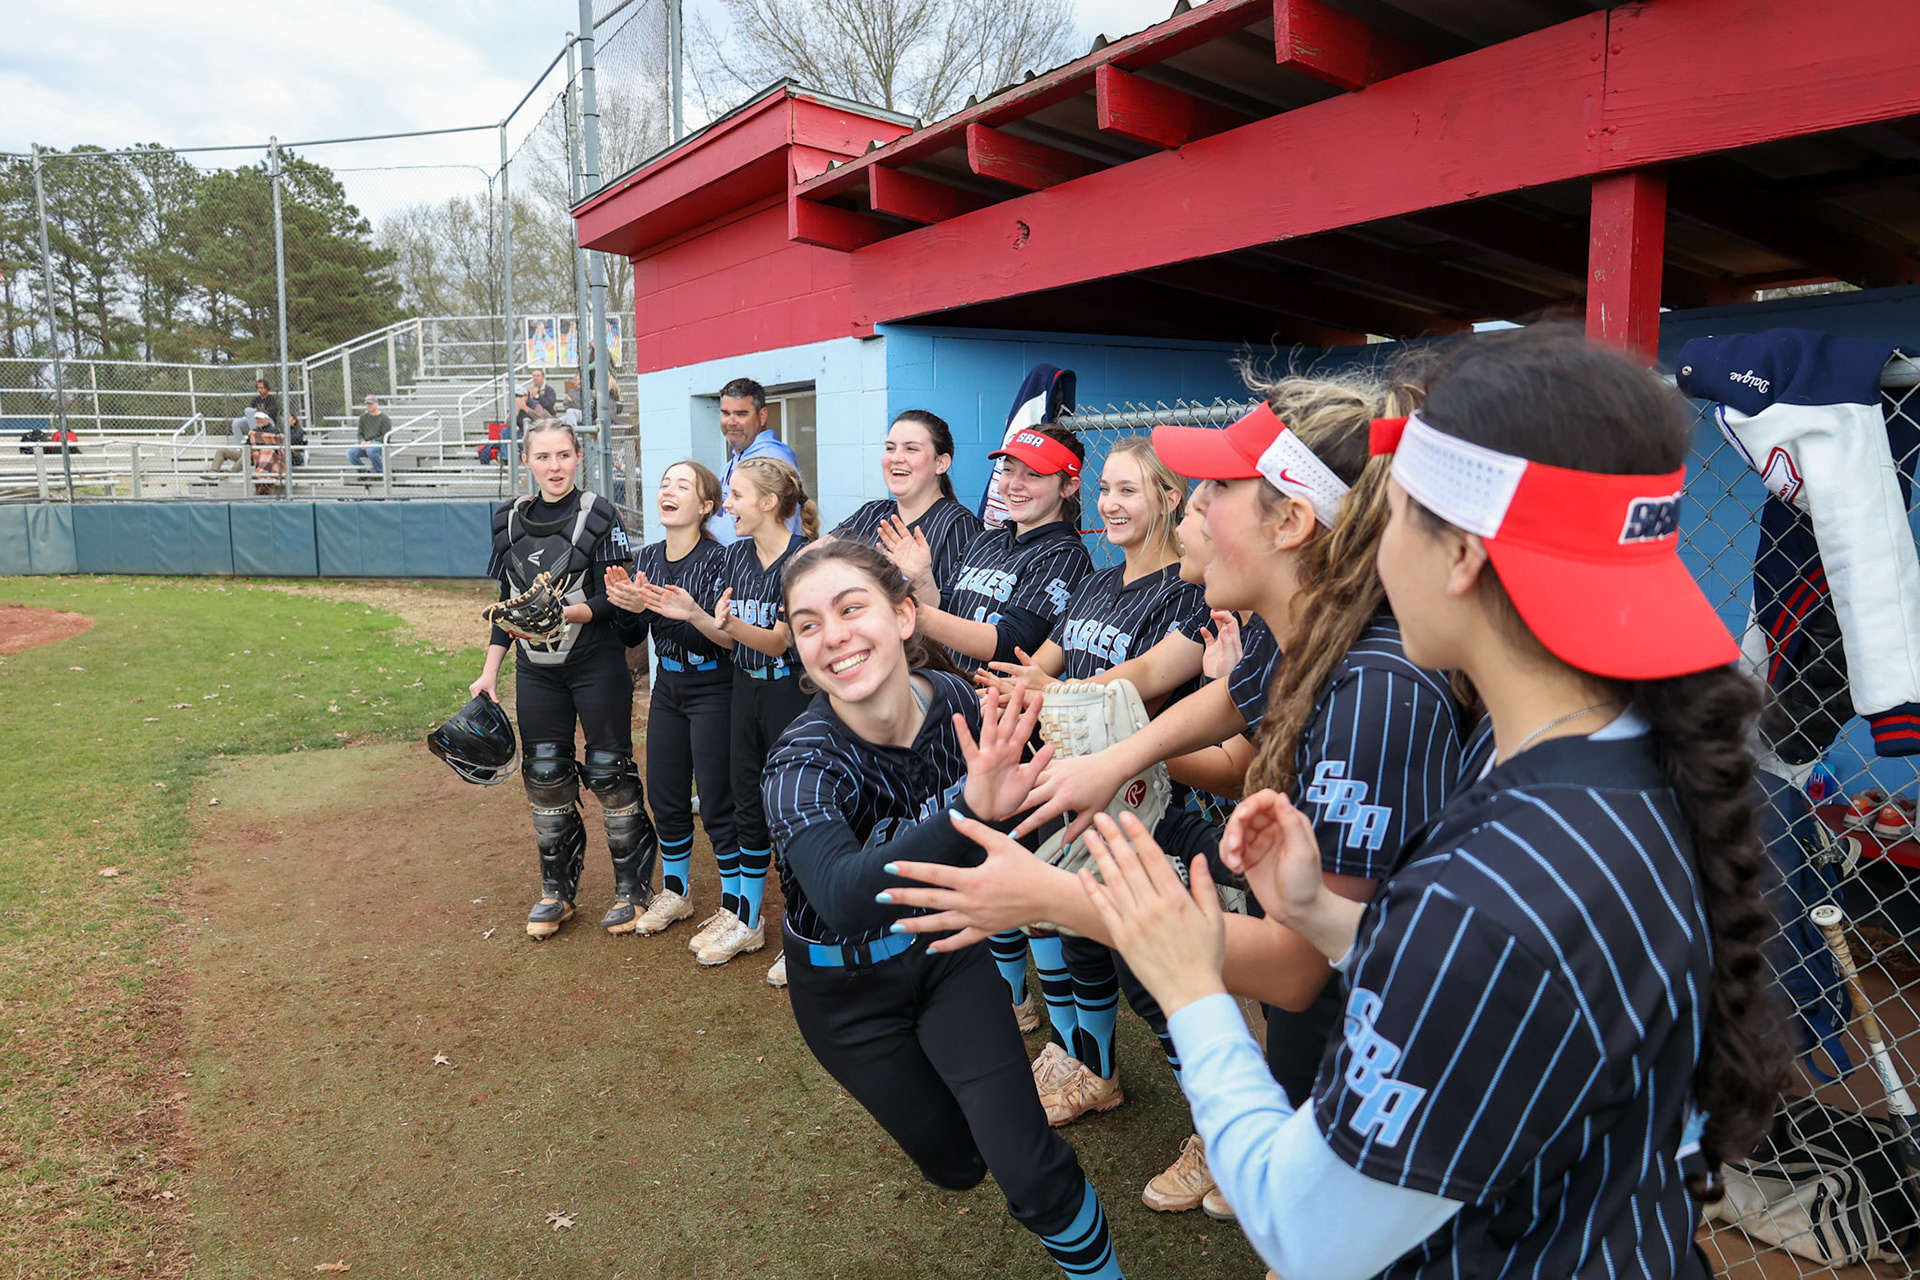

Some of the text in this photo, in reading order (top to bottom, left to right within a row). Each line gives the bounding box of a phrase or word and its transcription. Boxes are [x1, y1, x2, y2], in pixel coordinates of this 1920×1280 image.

[1729, 369, 1771, 394] Daigre
[1016, 432, 1045, 448] SBA
[1063, 618, 1133, 666] EAGLES
[1306, 760, 1393, 851] SBA
[1344, 986, 1428, 1148] SBA
